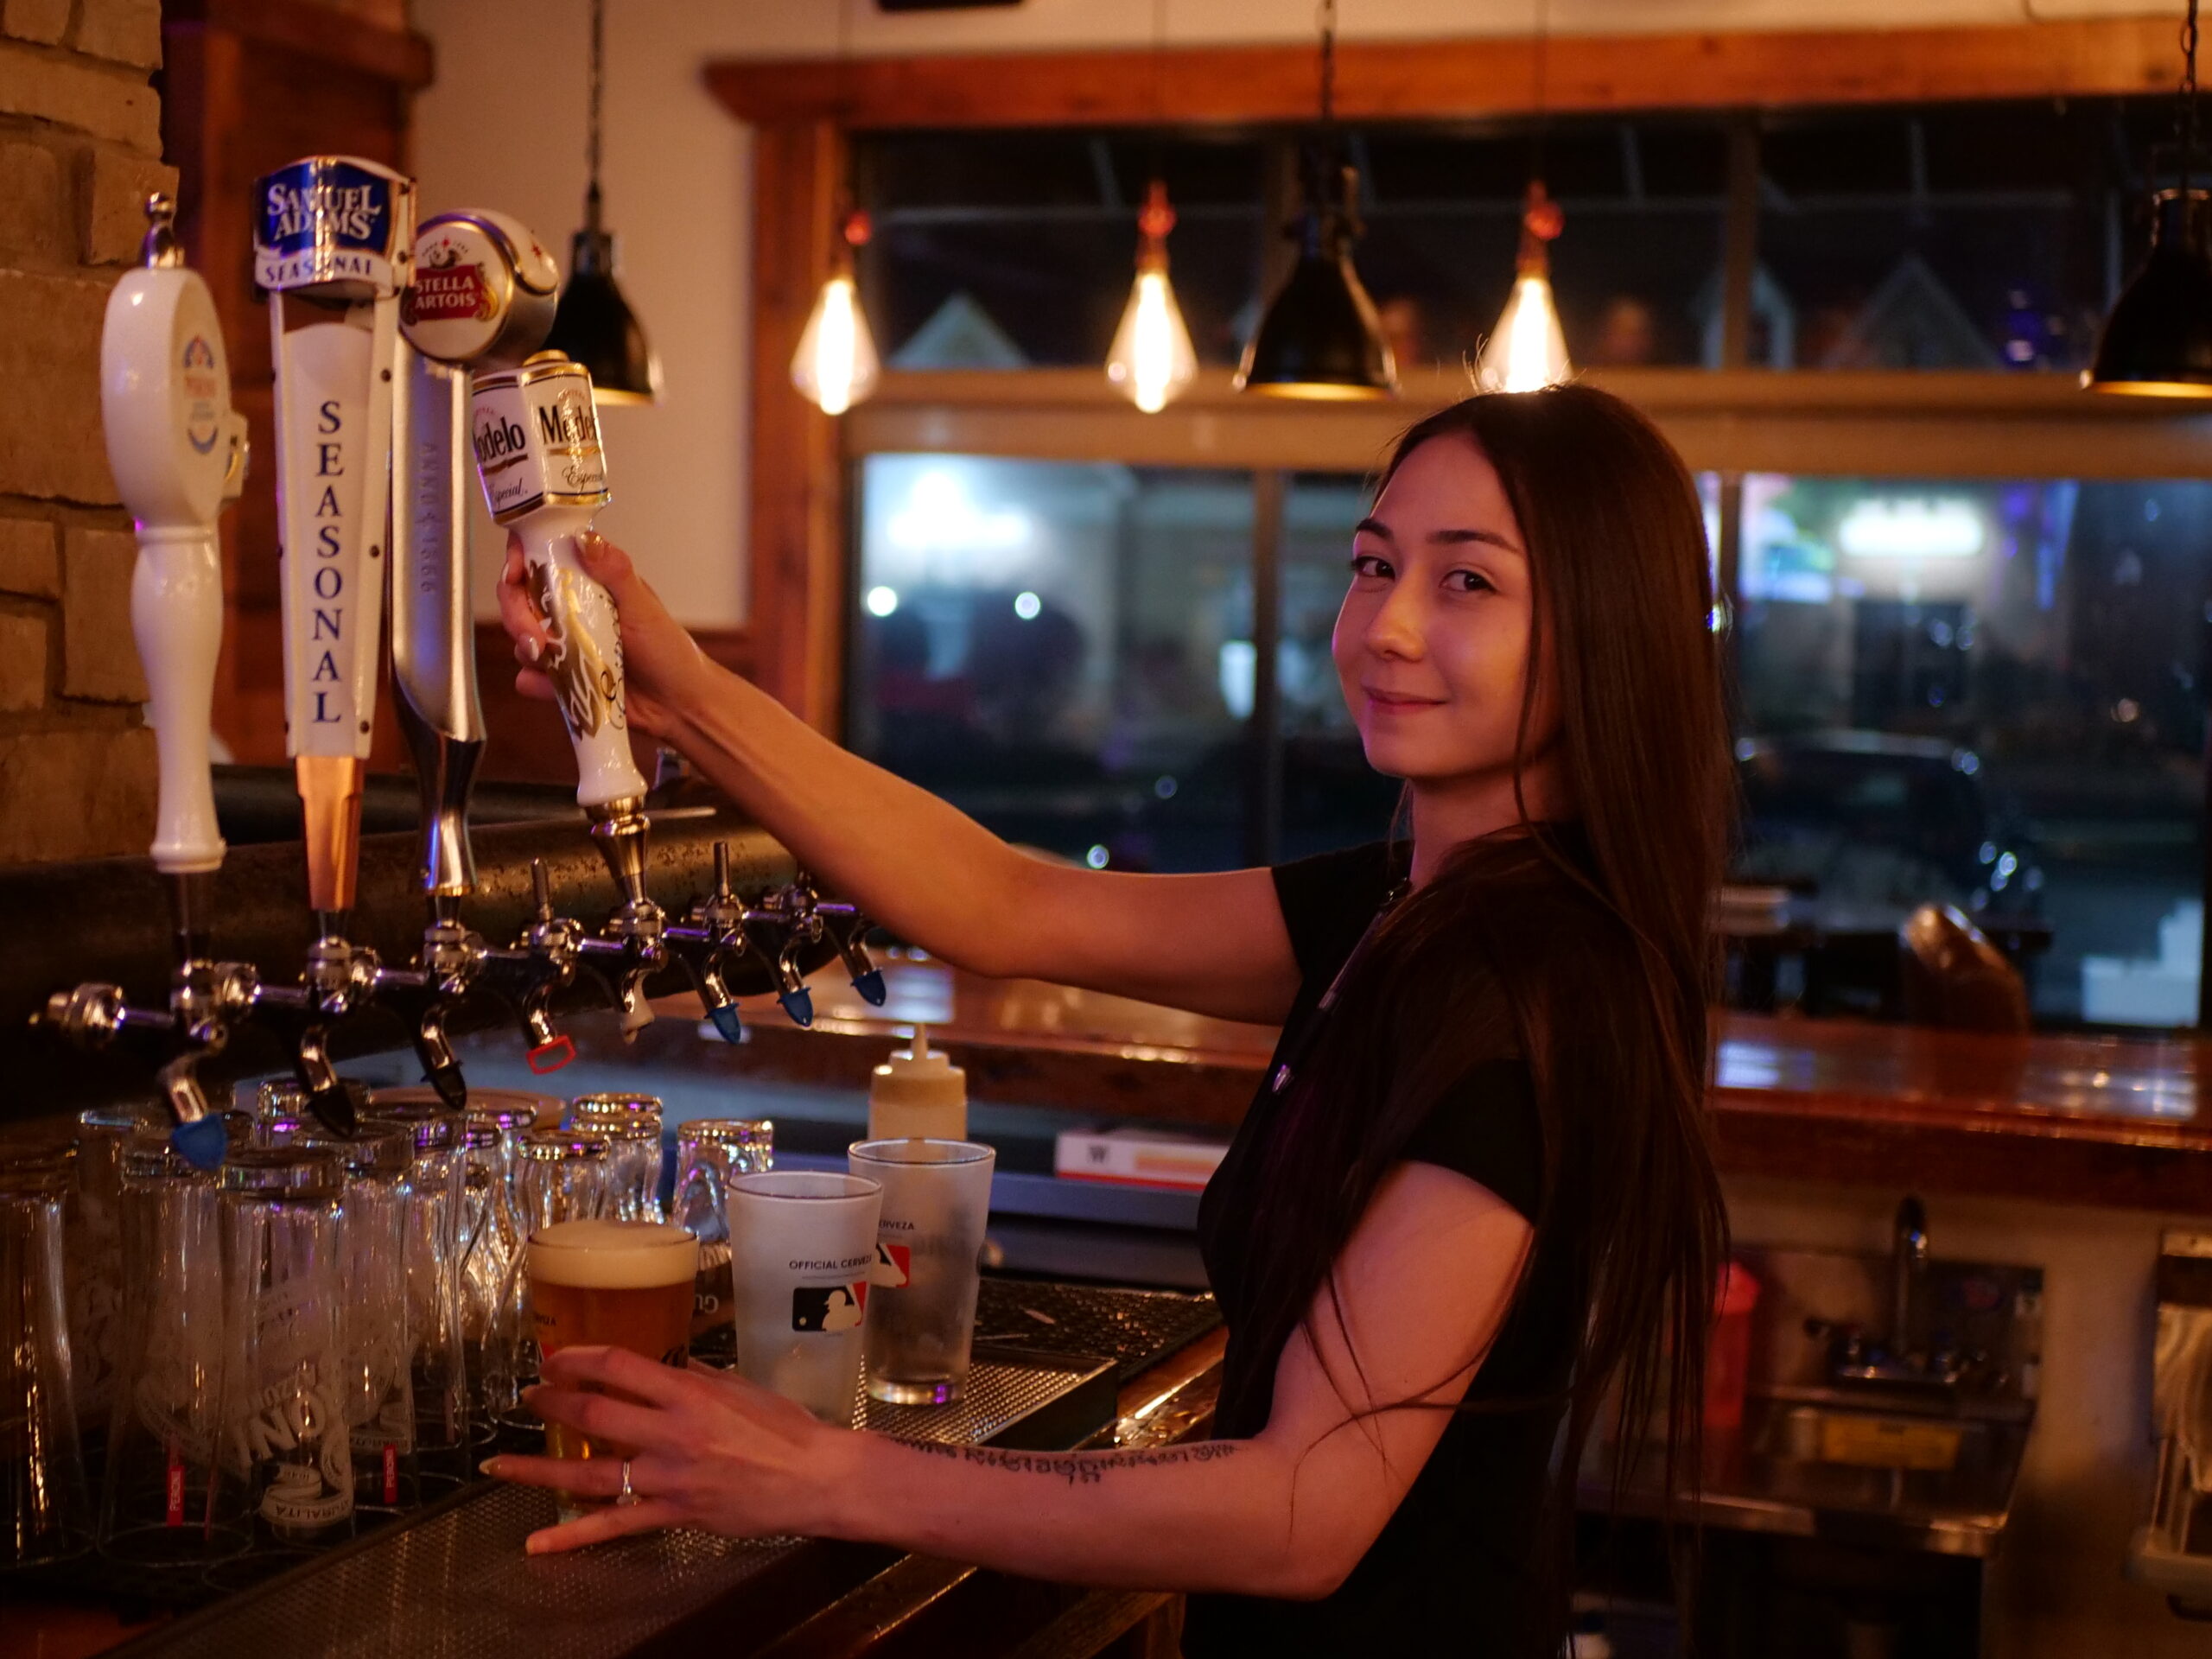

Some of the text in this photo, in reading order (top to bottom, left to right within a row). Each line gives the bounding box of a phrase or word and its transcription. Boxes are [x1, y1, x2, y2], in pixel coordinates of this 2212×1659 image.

[274, 211, 372, 241] ADMS
[265, 257, 372, 282] SEASNAL
[415, 275, 475, 293] STELLA
[415, 294, 475, 309] ARTOIS
[538, 404, 598, 445] Model
[474, 415, 525, 463] odelo
[312, 400, 345, 723] SEASONAL
[878, 1219, 914, 1230] ERVEZA
[789, 1258, 838, 1270] OFFICIAL
